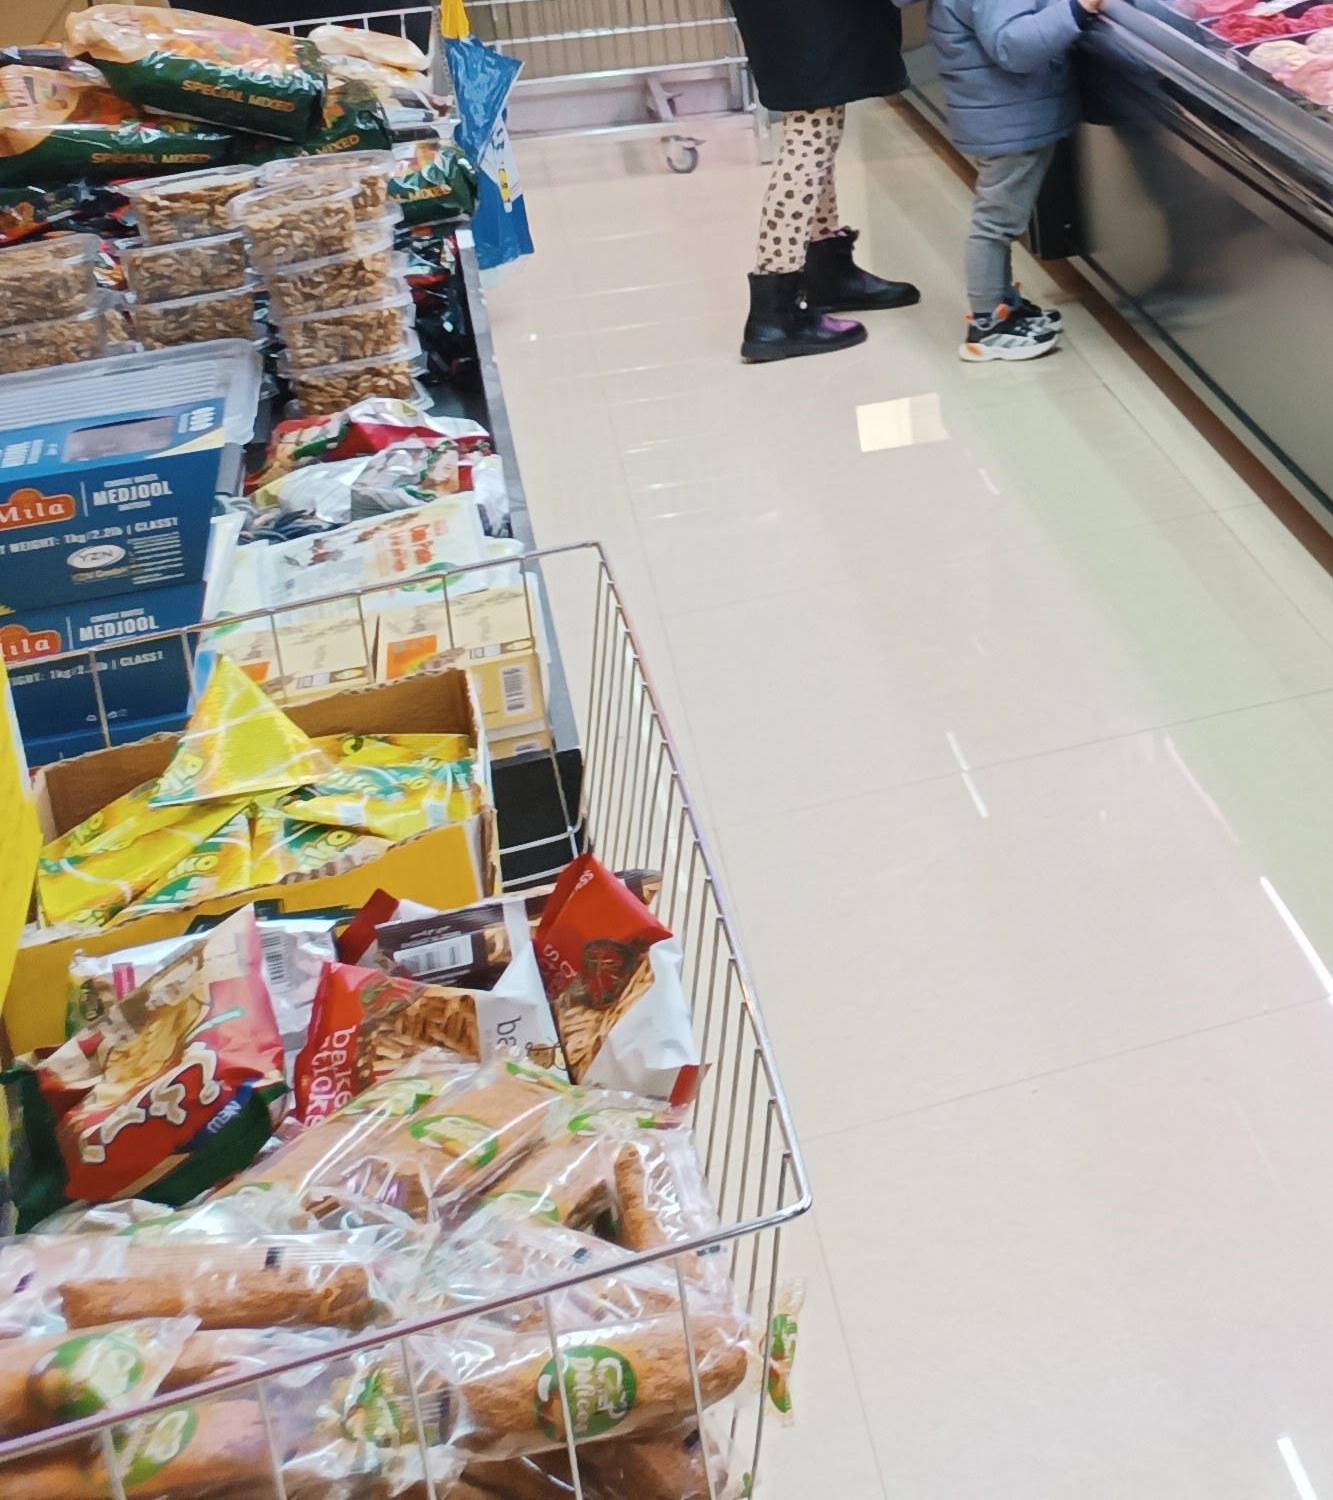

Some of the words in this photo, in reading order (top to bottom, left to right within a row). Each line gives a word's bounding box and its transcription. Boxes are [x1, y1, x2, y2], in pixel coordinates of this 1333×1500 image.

[181, 79, 244, 103] SPECIAL
[247, 94, 296, 113] MIXED
[92, 480, 174, 507] MEDJOOL
[79, 614, 161, 643] MEDJOOL
[206, 1099, 242, 1135] NEW
